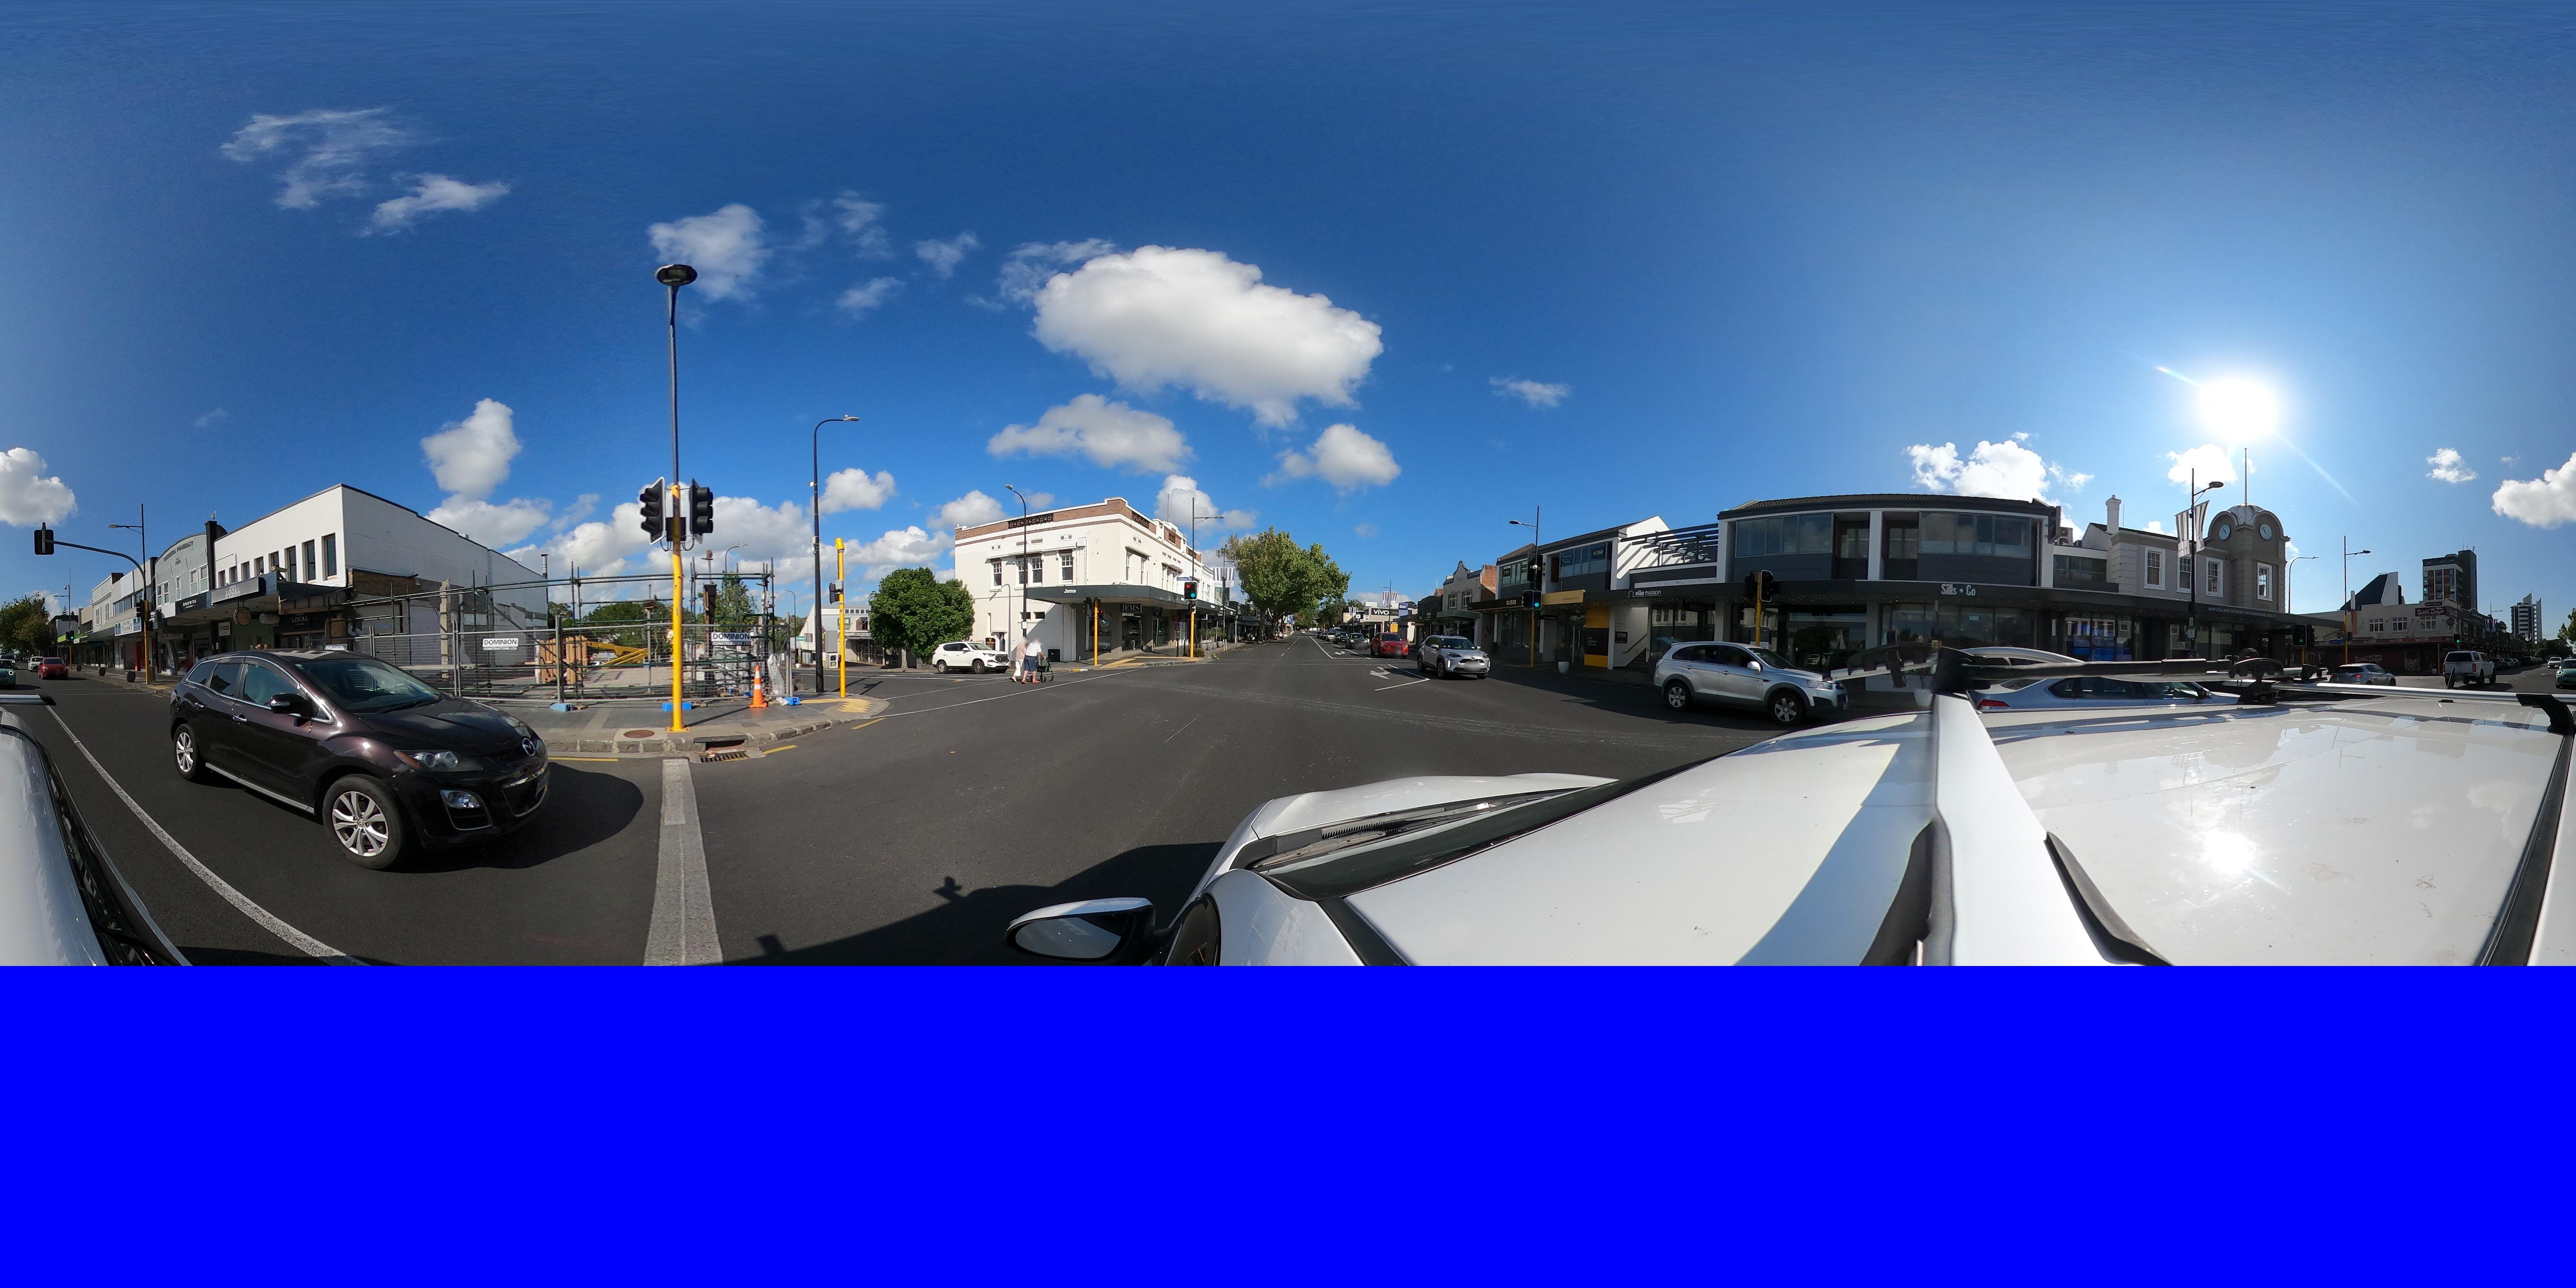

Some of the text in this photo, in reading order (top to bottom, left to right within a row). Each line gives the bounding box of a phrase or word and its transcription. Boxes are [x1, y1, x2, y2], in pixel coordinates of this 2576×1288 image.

[177, 541, 194, 552] PHARMACY
[225, 587, 240, 597] LOCAL
[1941, 583, 1957, 595] Sills
[1966, 585, 1976, 596] Co
